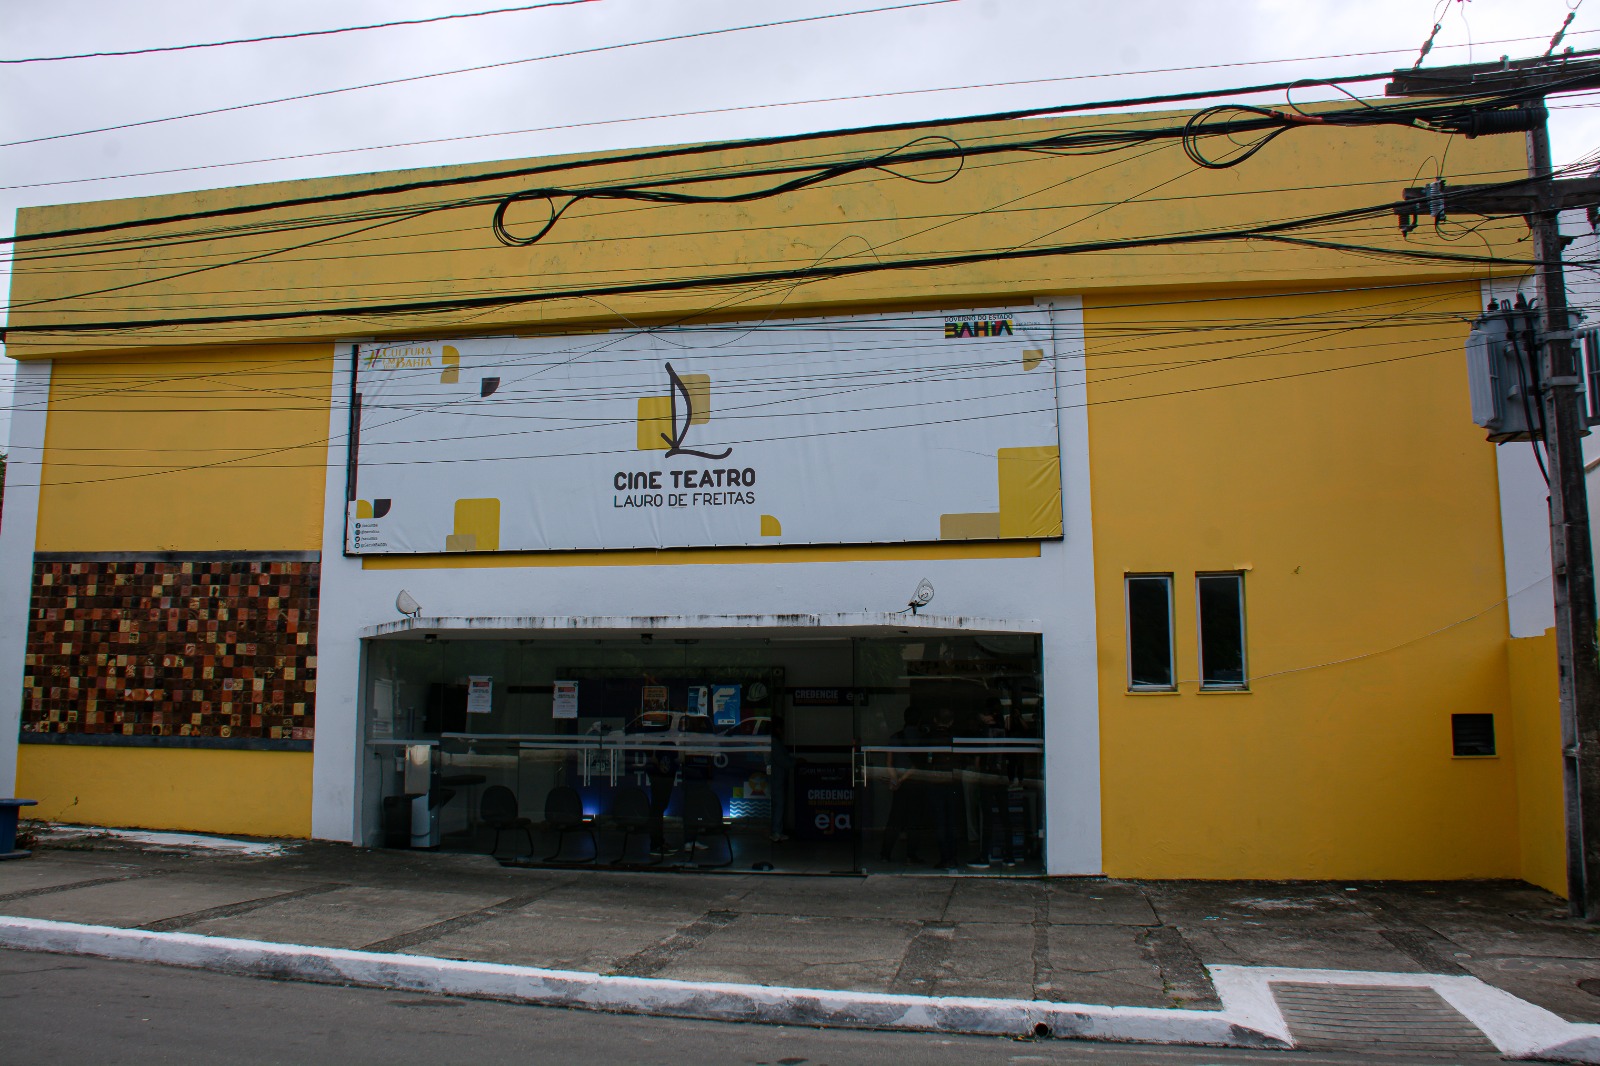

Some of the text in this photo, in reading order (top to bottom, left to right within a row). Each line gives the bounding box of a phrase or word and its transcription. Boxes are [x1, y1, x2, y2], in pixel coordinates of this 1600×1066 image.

[989, 313, 1013, 321] ESTADO
[945, 320, 1013, 338] BAHIA
[614, 468, 756, 490] CINE TEATRO
[614, 491, 756, 507] LAURO DE FREITAS
[795, 689, 839, 699] CREDENCIE
[808, 789, 855, 800] CREDENCI
